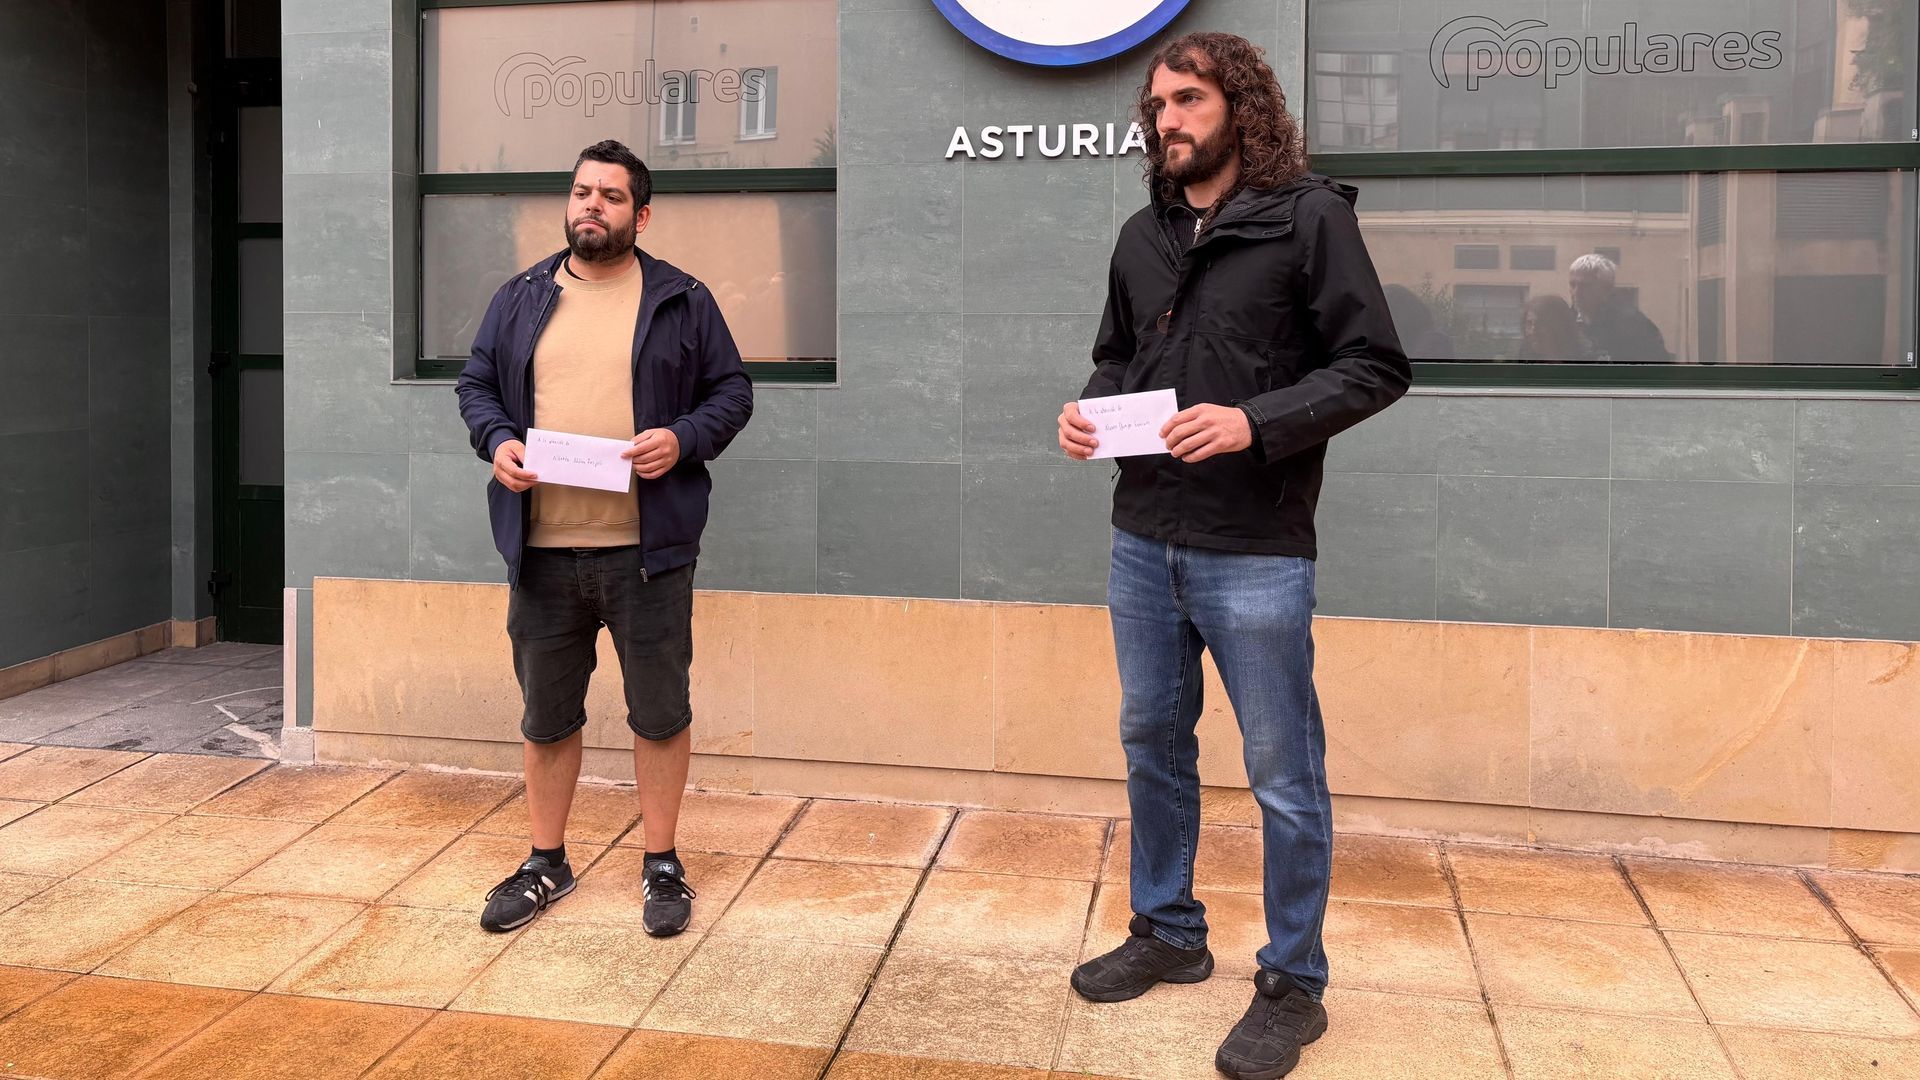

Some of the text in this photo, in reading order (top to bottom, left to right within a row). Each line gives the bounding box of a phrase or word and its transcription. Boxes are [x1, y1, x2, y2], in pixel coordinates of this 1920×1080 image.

[1466, 22, 1783, 91] populares
[523, 58, 766, 119] populares
[945, 122, 1148, 158] ASTURIA
